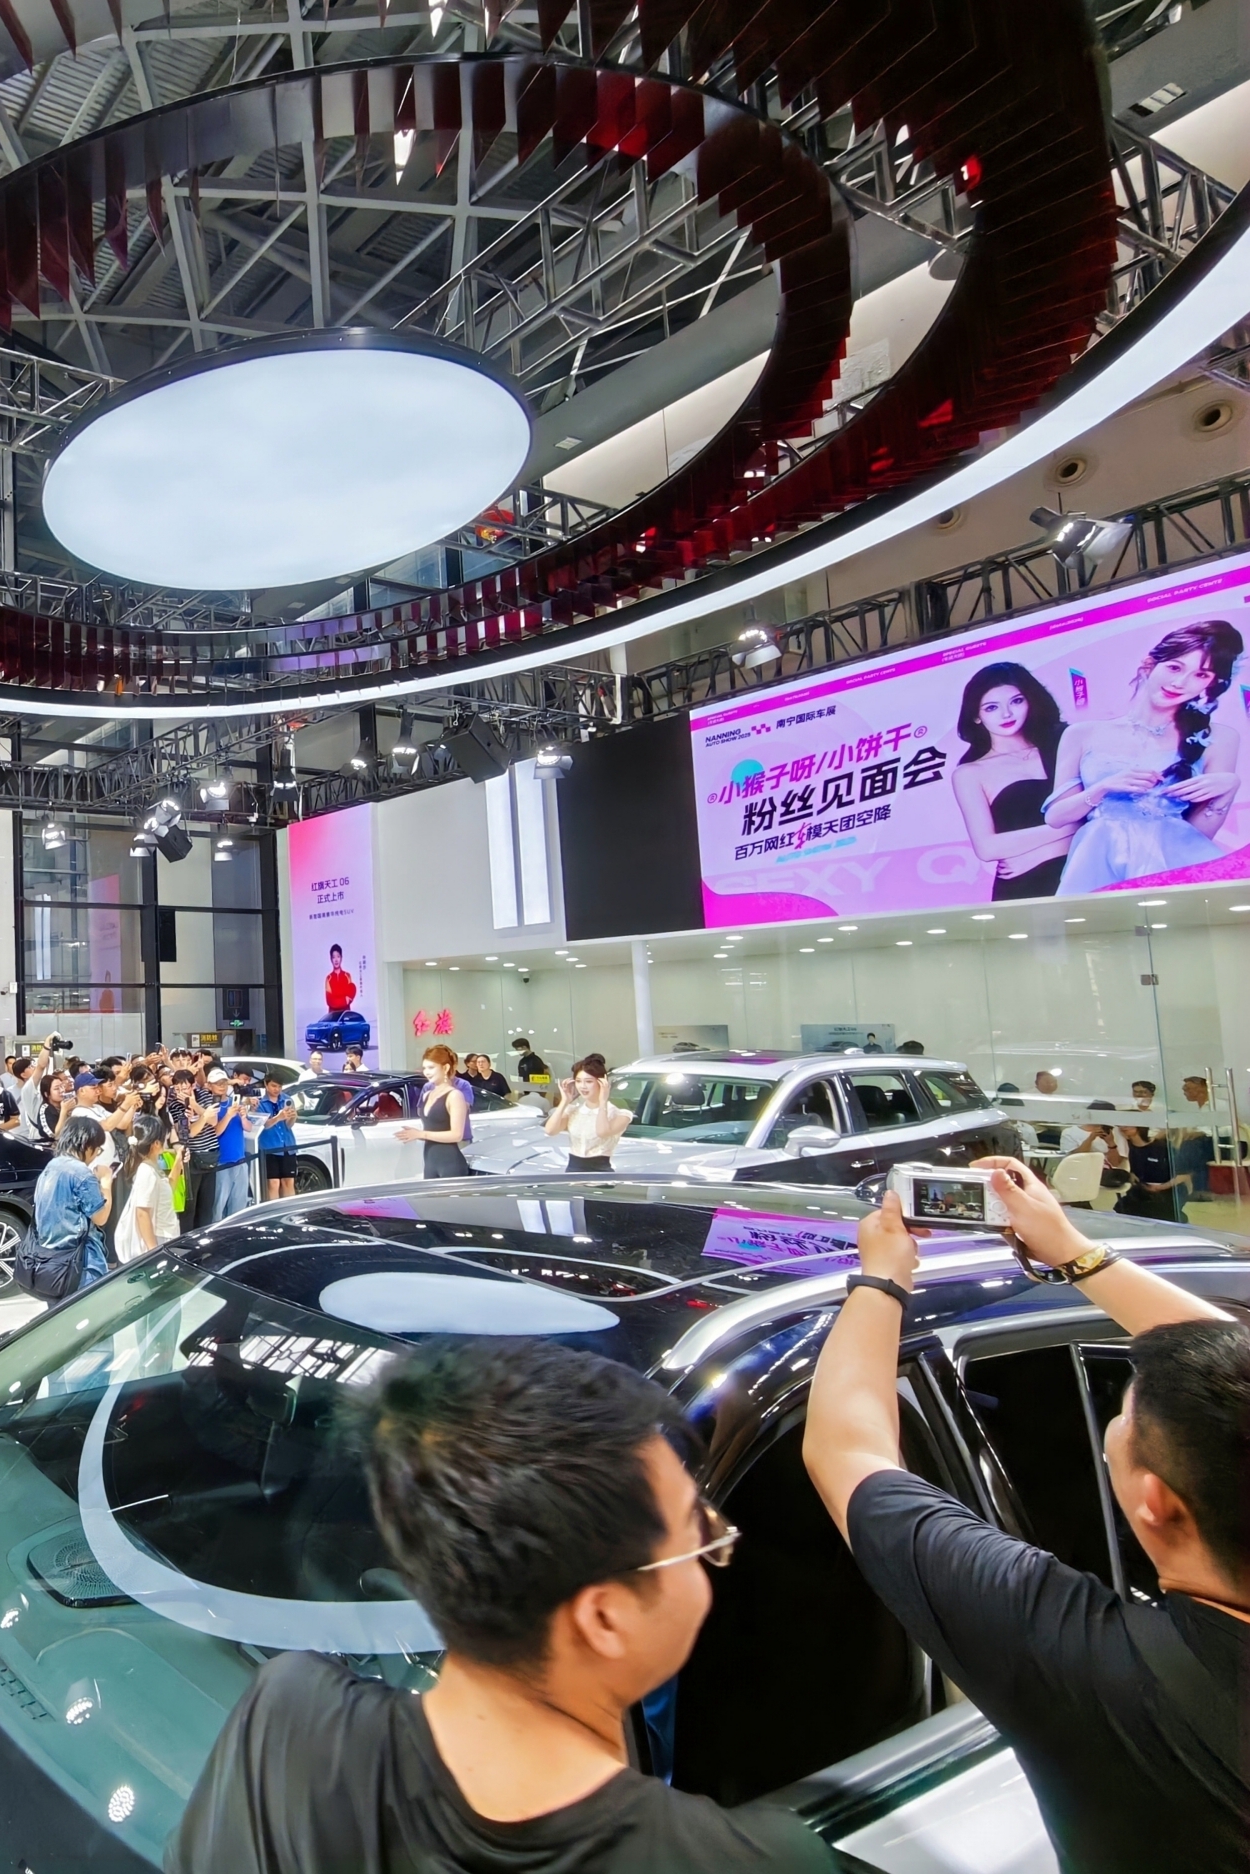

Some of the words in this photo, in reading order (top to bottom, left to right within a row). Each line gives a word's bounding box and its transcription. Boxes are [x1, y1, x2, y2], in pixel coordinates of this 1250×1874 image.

[775, 705, 837, 730] 南宁国际车展
[705, 728, 742, 743] NANNING
[741, 745, 947, 836] 粉丝见面会
[311, 879, 338, 891] 红旗天工
[317, 891, 345, 904] 正式上市
